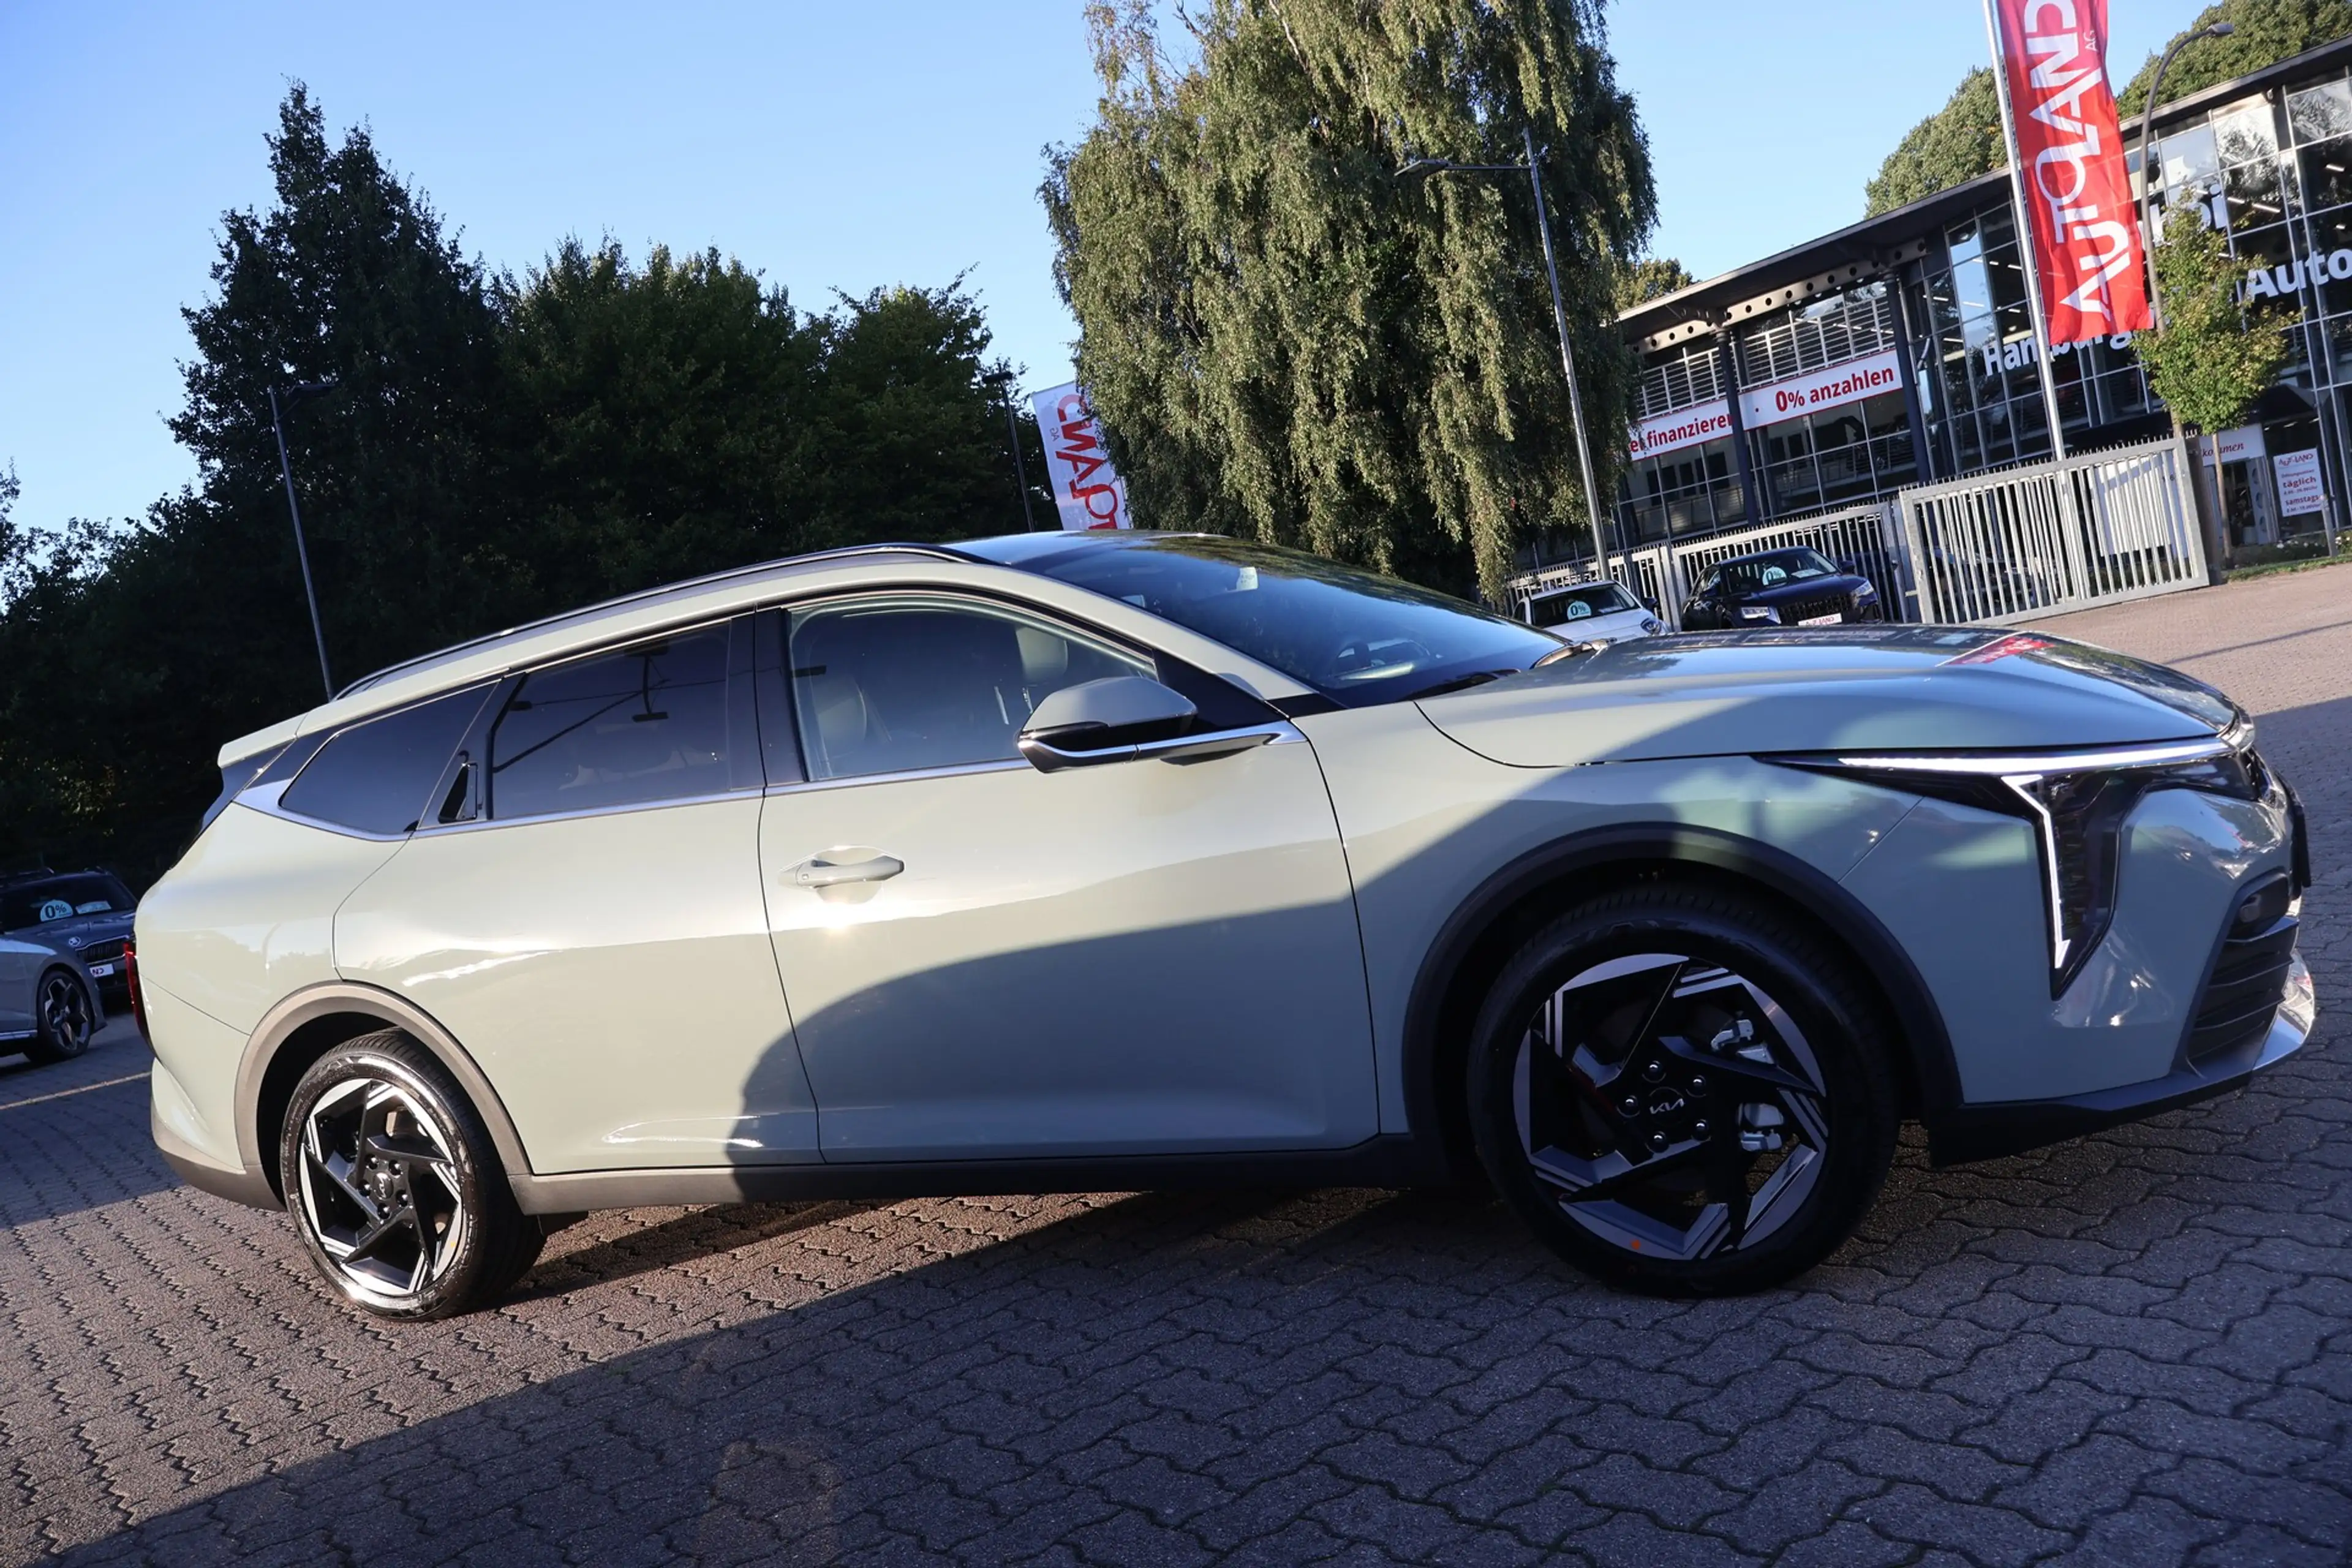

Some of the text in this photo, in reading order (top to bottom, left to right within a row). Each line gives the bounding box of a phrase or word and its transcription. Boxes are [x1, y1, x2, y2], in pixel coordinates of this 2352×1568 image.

[2083, 29, 2097, 51] AG
[2024, 0, 2132, 322] AUTOLAND
[1776, 390, 1805, 412] 0%
[1810, 367, 1894, 403] anzahlen
[2203, 442, 2244, 457] komen
[45, 904, 67, 918] 0%
